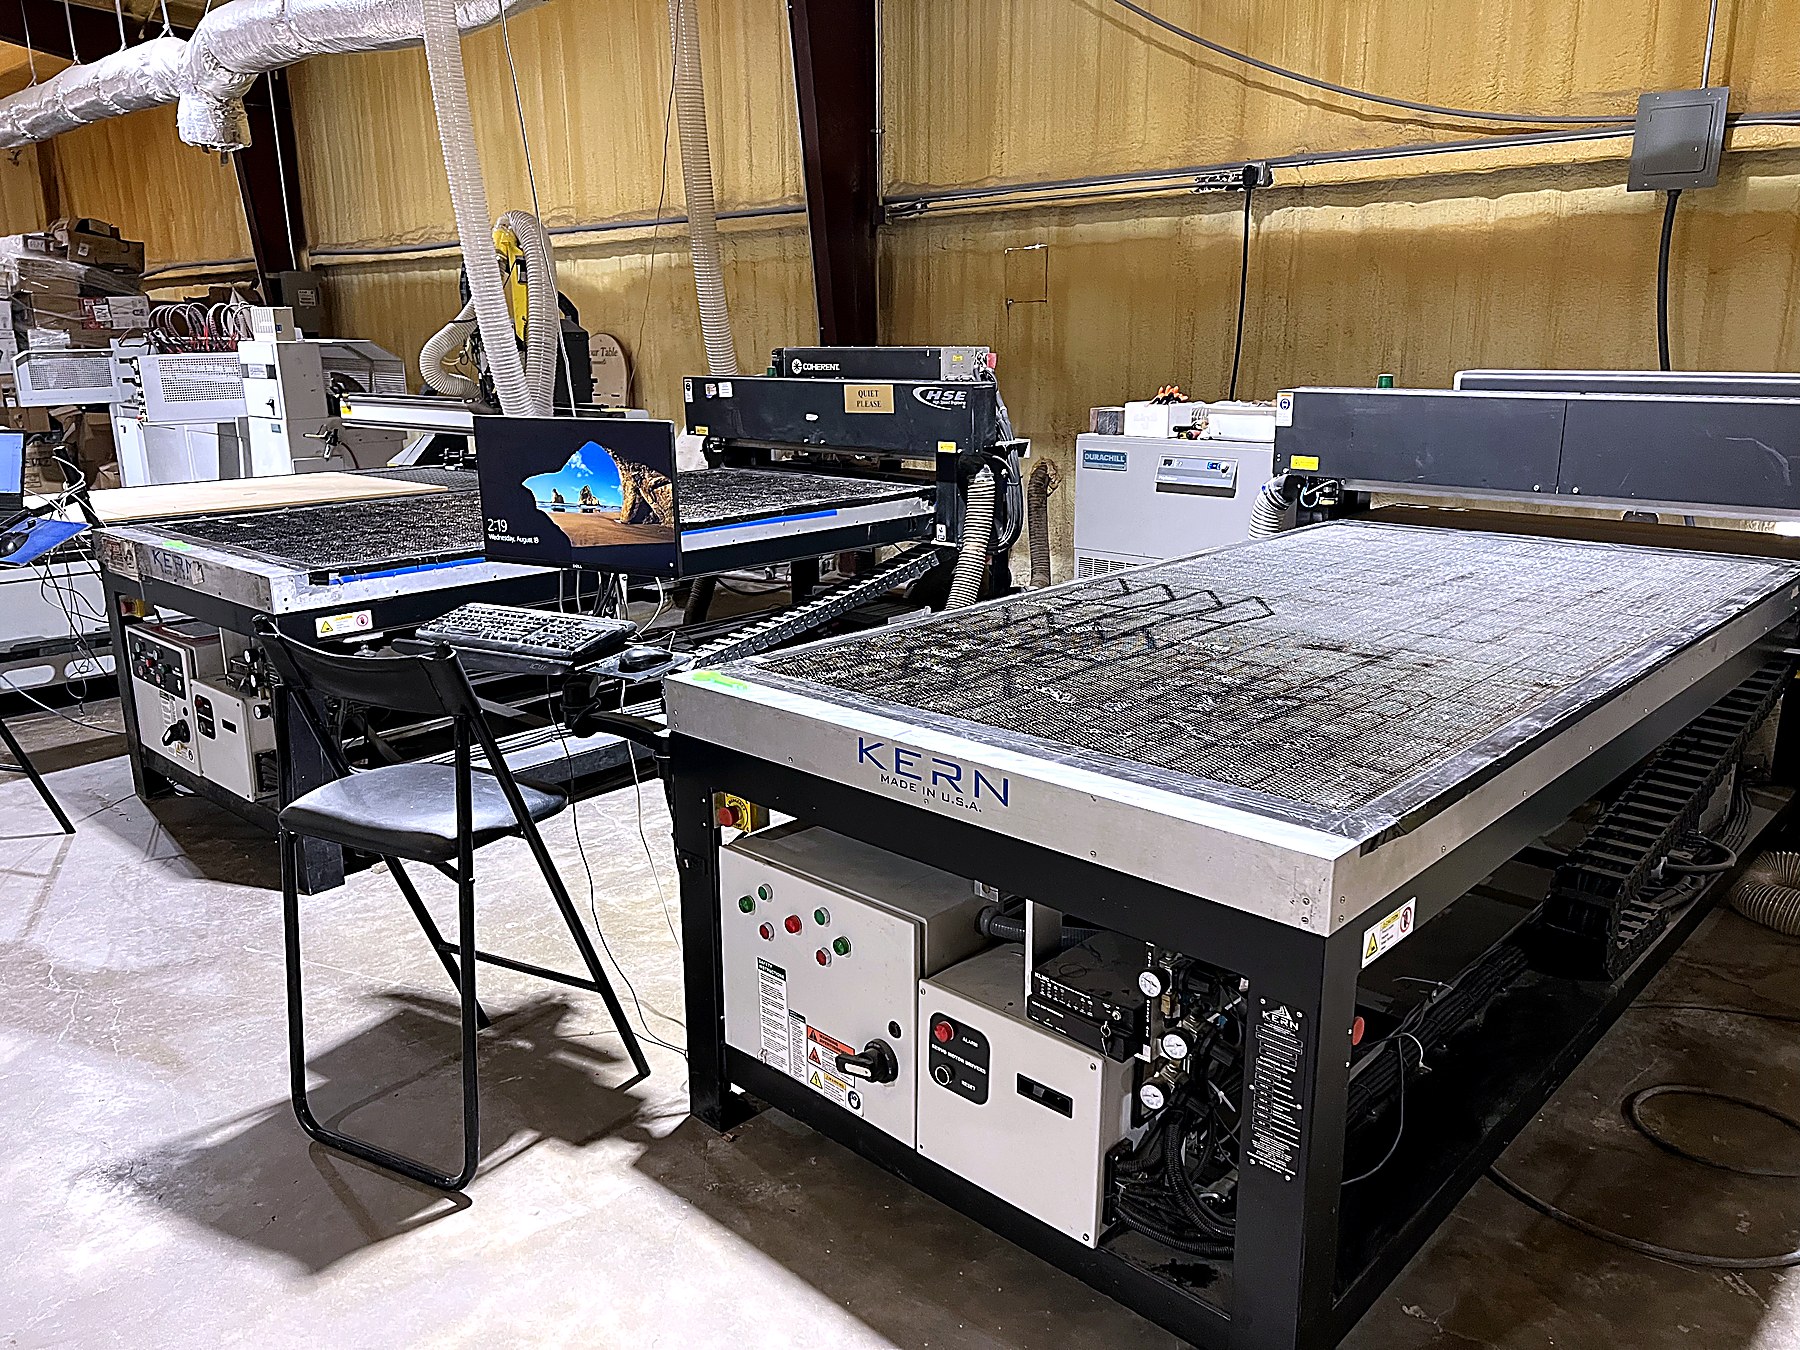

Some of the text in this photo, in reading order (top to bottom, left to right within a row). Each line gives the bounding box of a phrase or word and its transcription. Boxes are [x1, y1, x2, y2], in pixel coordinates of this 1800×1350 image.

[600, 347, 618, 357] Table
[803, 363, 839, 371] COHERENT
[857, 389, 879, 399] QUIET
[926, 390, 967, 401] HSE
[1084, 453, 1125, 463] DURACHILL
[487, 518, 508, 533] 2:19
[488, 533, 516, 543] Wednesday,
[516, 535, 533, 545] August
[858, 736, 1009, 807] KERN
[880, 773, 982, 813] MADE IN U.S.A.
[1262, 1010, 1299, 1031] KERN
